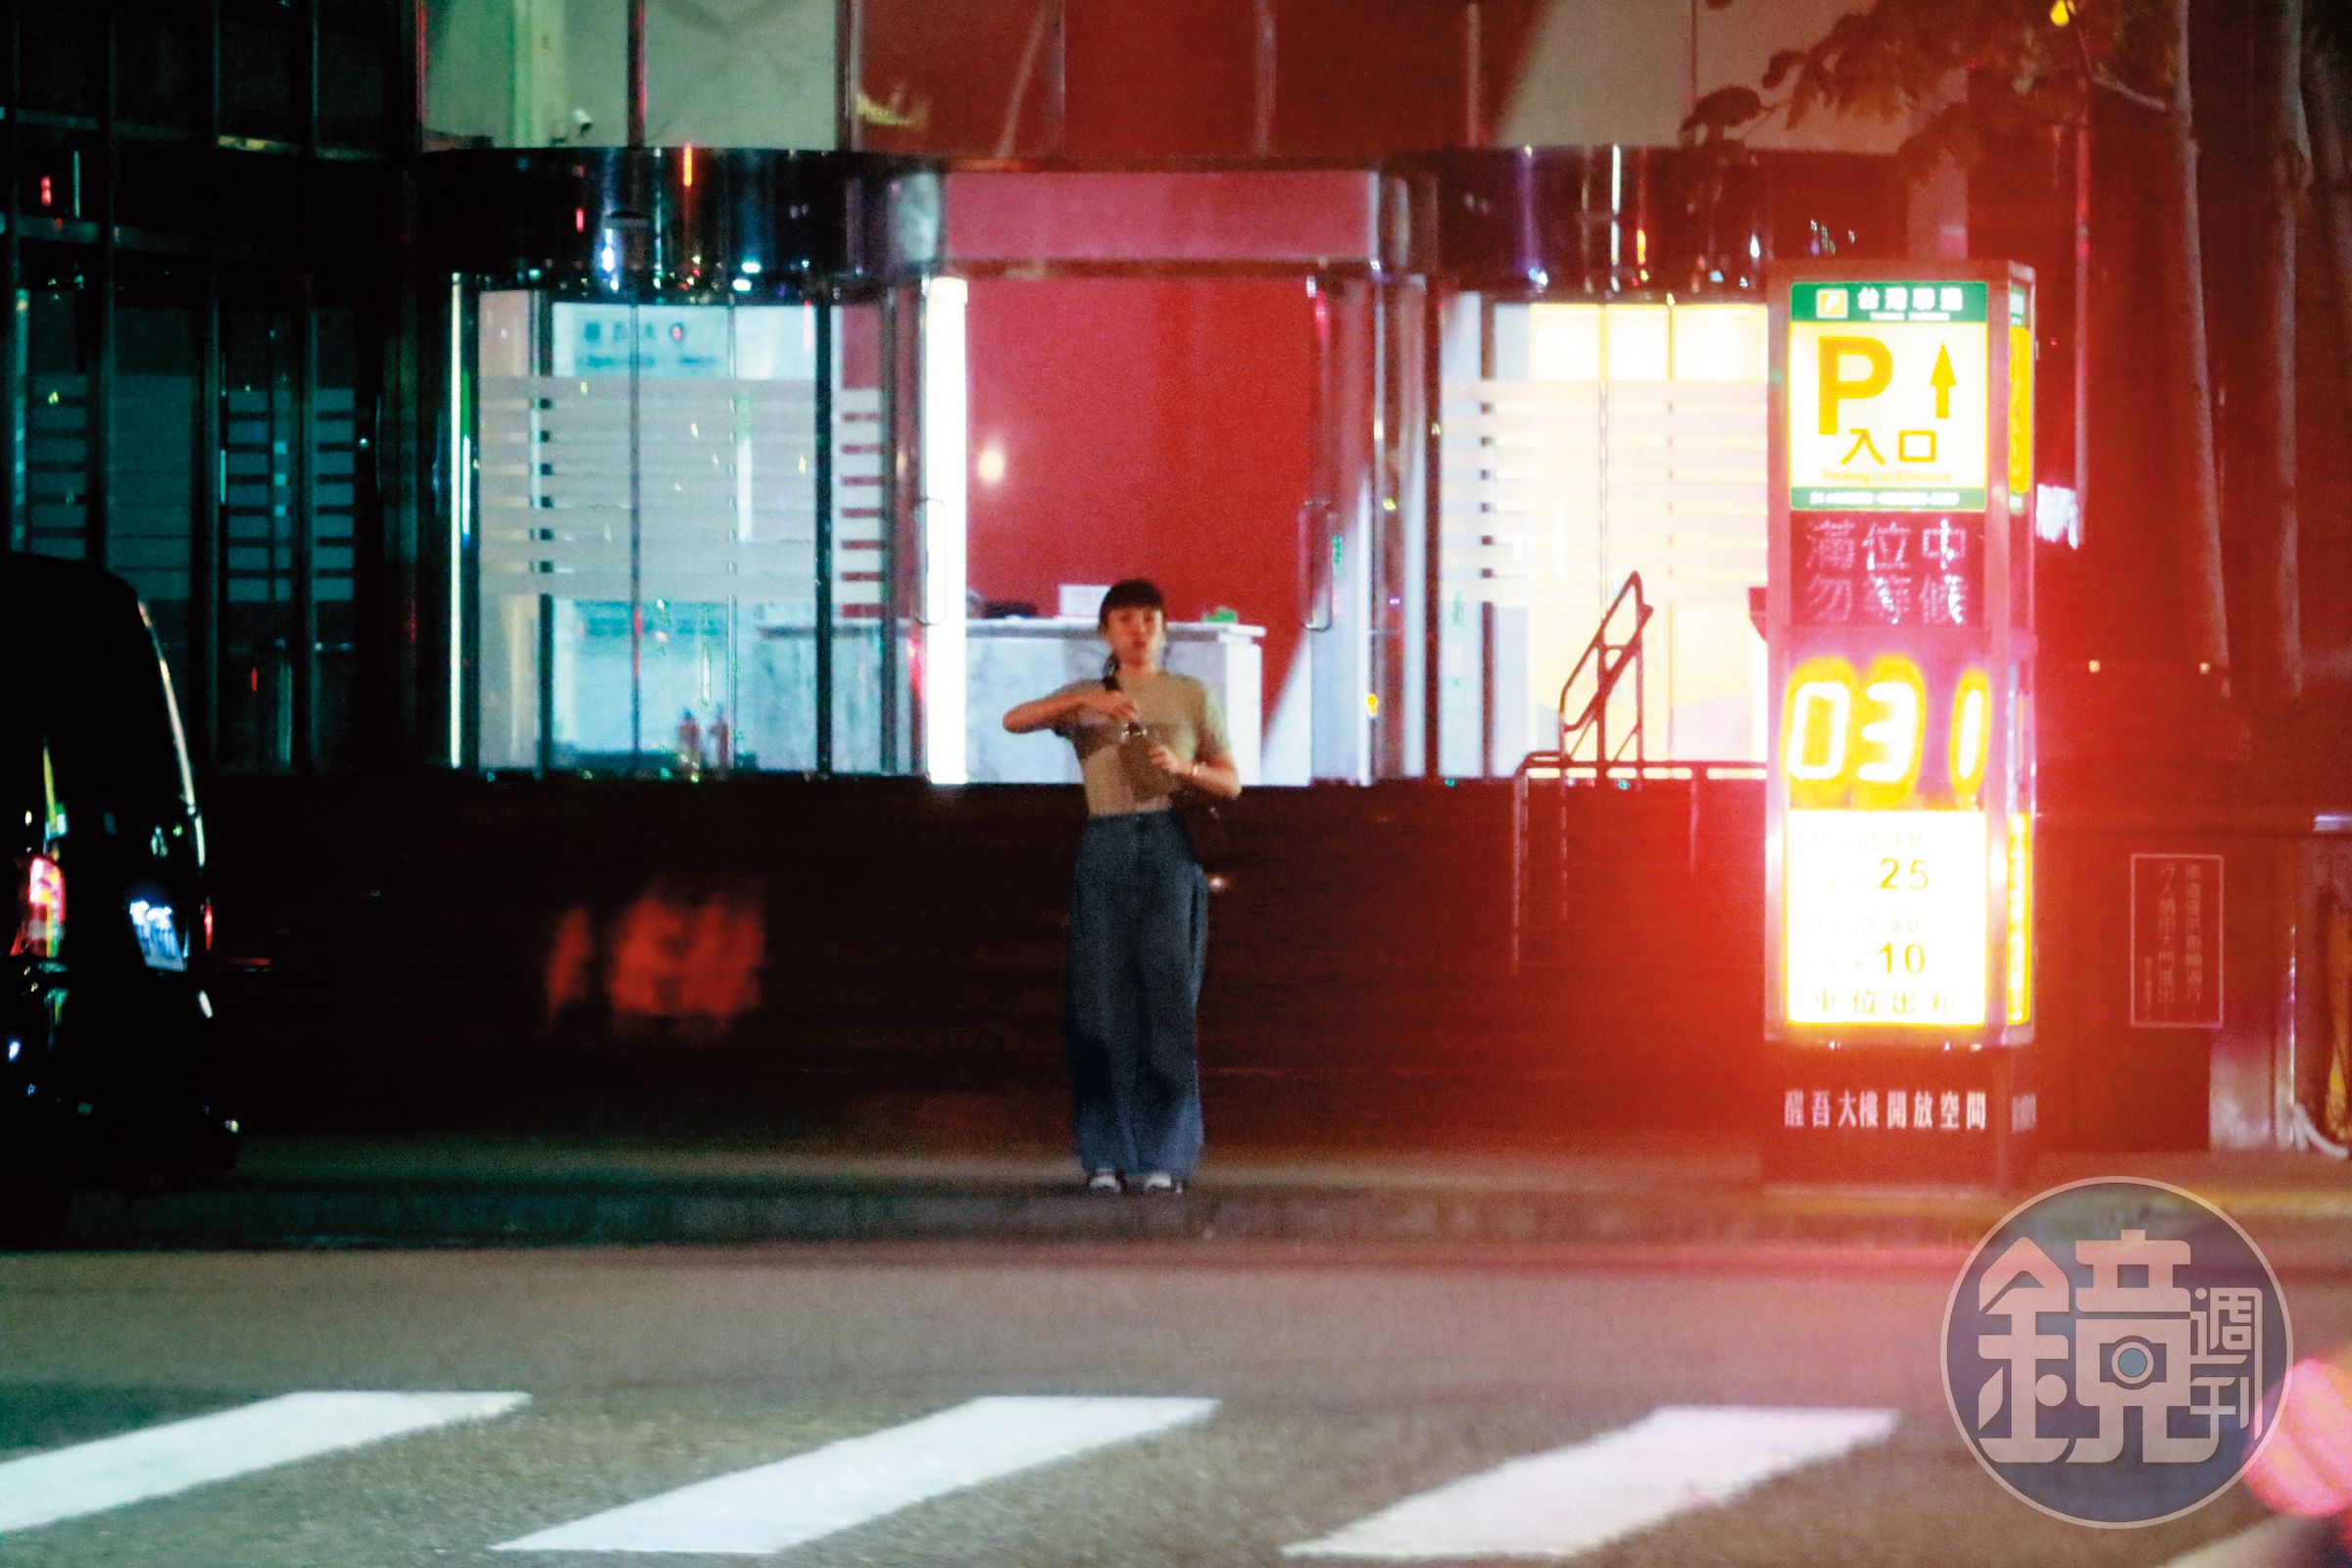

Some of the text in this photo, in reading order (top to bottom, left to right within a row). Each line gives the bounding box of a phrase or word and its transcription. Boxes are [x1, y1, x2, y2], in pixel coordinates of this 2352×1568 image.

[1818, 336, 1892, 435] P
[1840, 428, 1936, 465] 入口
[1787, 680, 1984, 783] 031
[1879, 858, 1930, 891] 25
[1878, 942, 1926, 975] 10
[1784, 1089, 1987, 1132] 醒吾大樓開放空間
